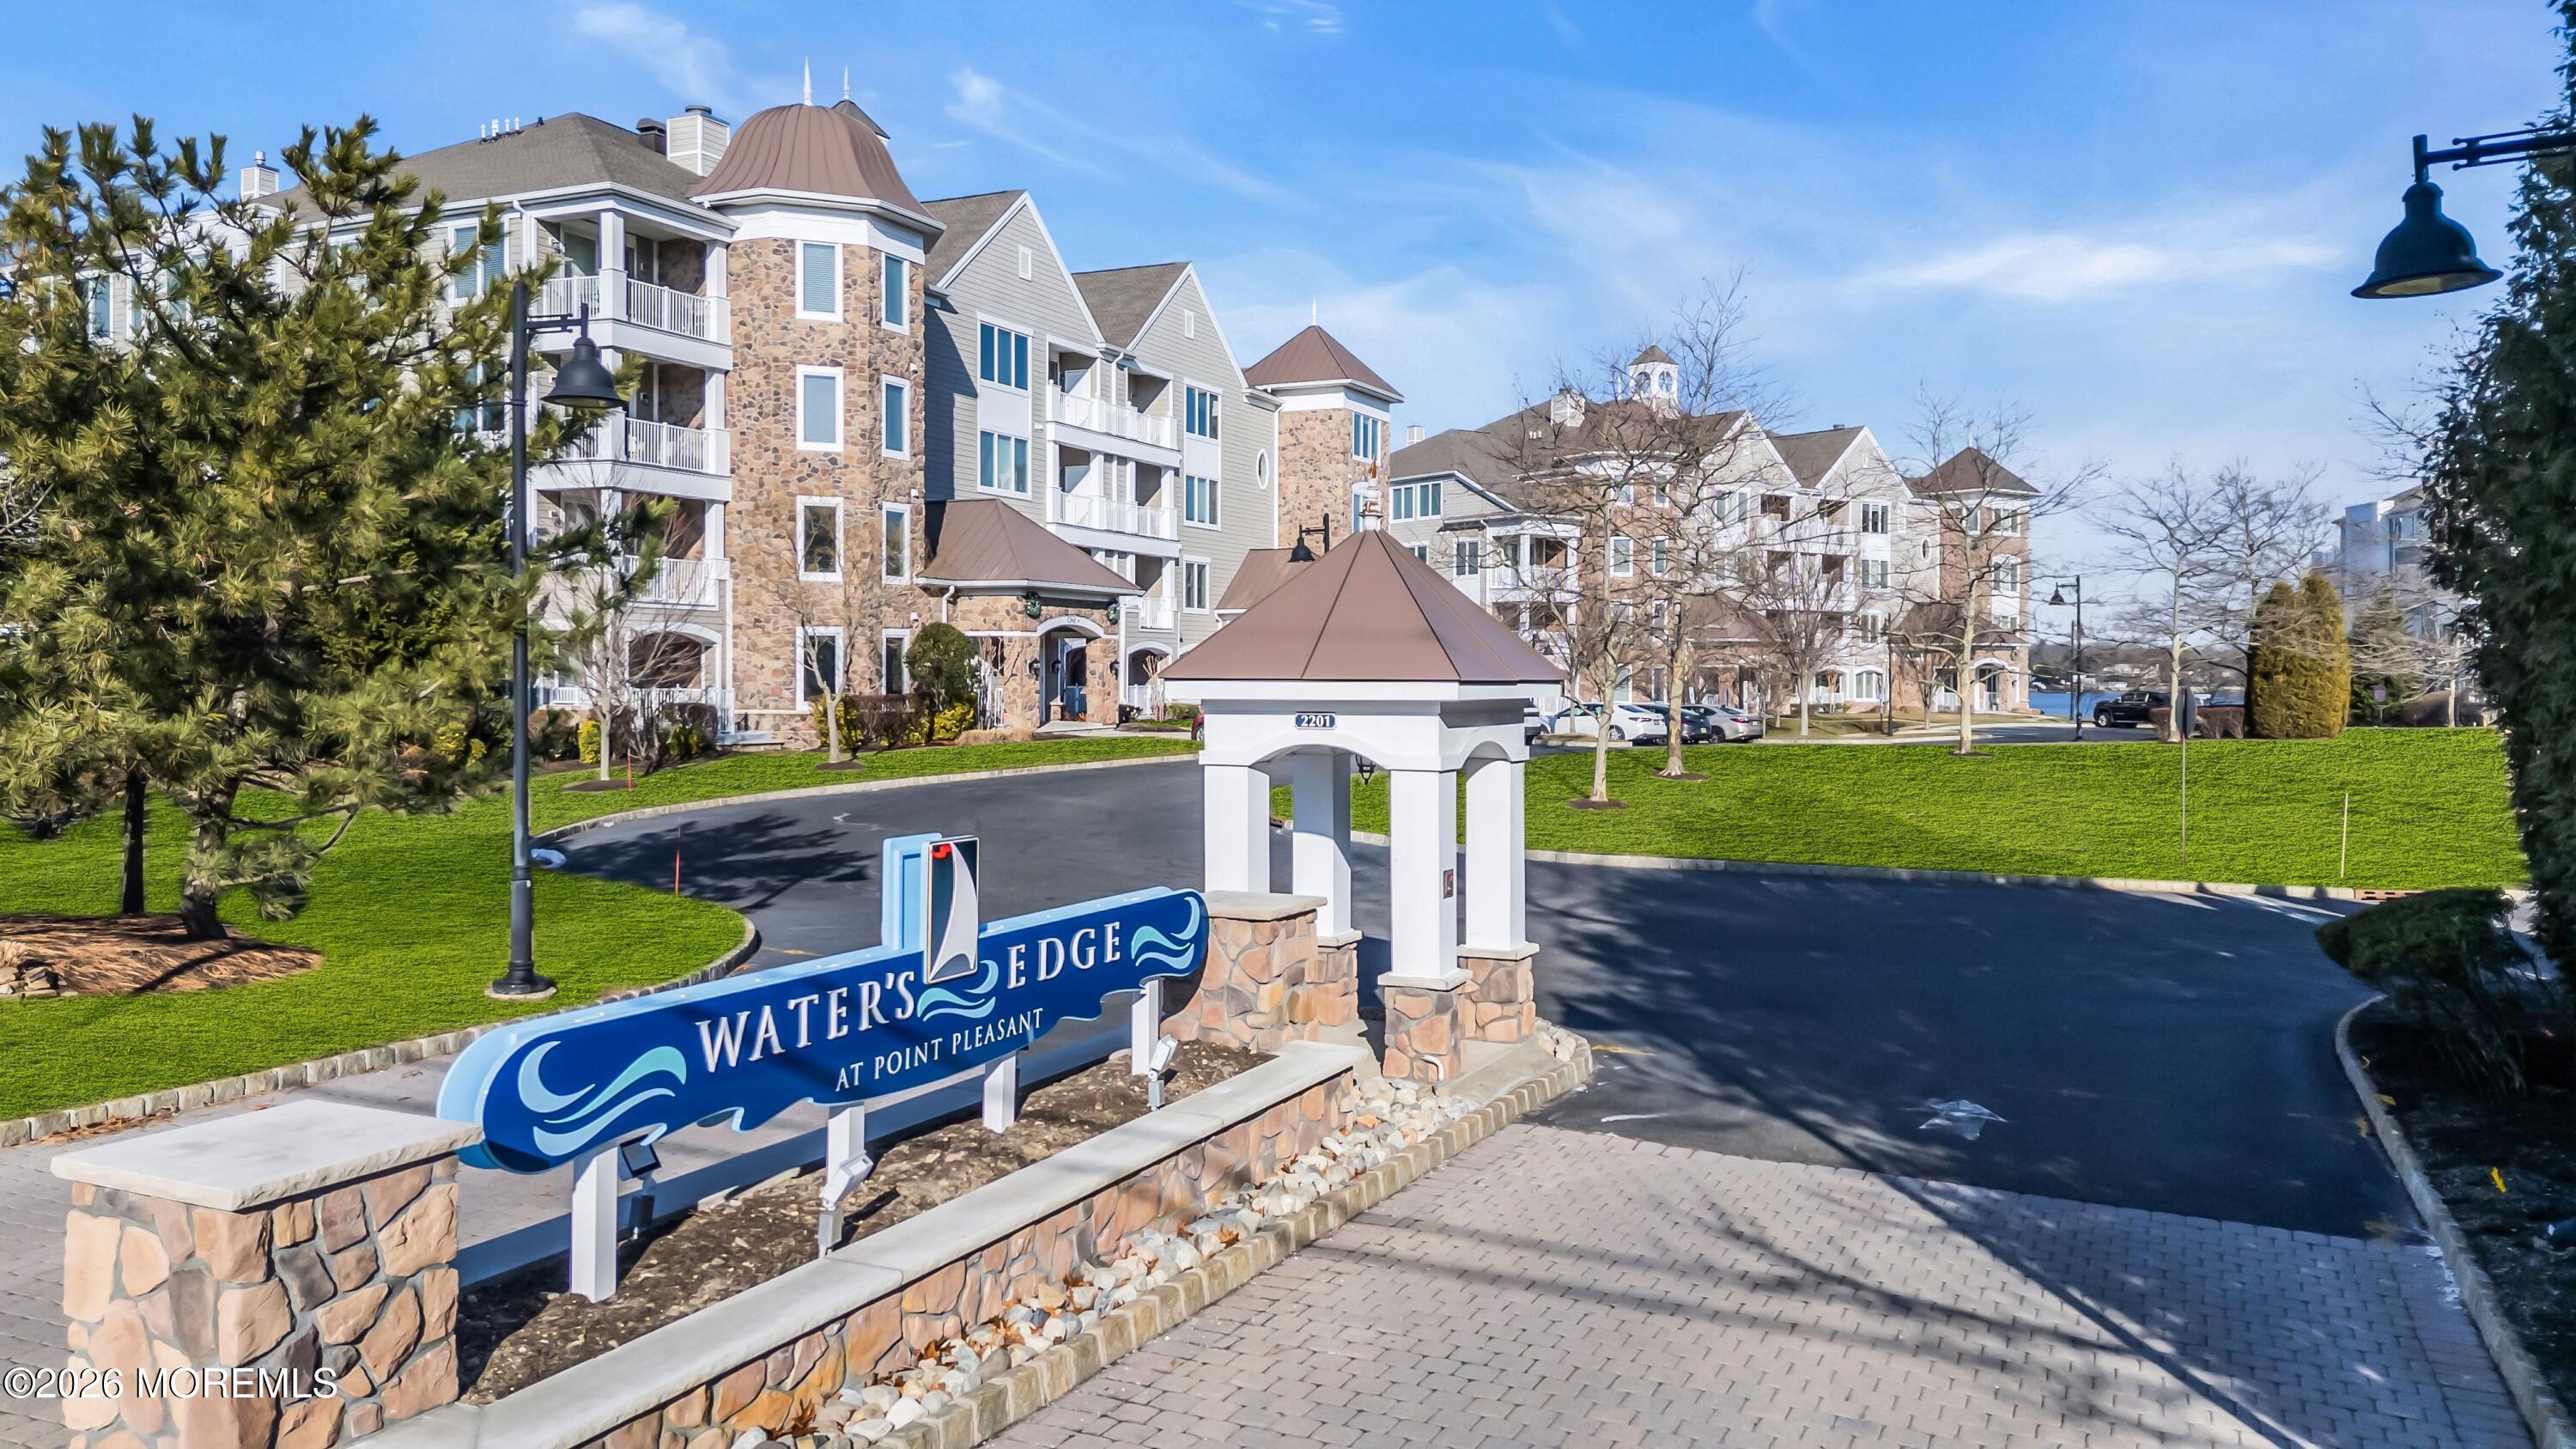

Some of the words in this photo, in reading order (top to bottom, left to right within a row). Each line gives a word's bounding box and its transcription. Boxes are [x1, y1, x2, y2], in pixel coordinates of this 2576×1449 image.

[1301, 715, 1330, 728] 2201
[695, 971, 914, 1073] WATER'S
[1007, 921, 1121, 989] EDGE
[835, 1062, 864, 1092] AT
[874, 1038, 943, 1080] POINT
[951, 1008, 1043, 1055] PLEASANT
